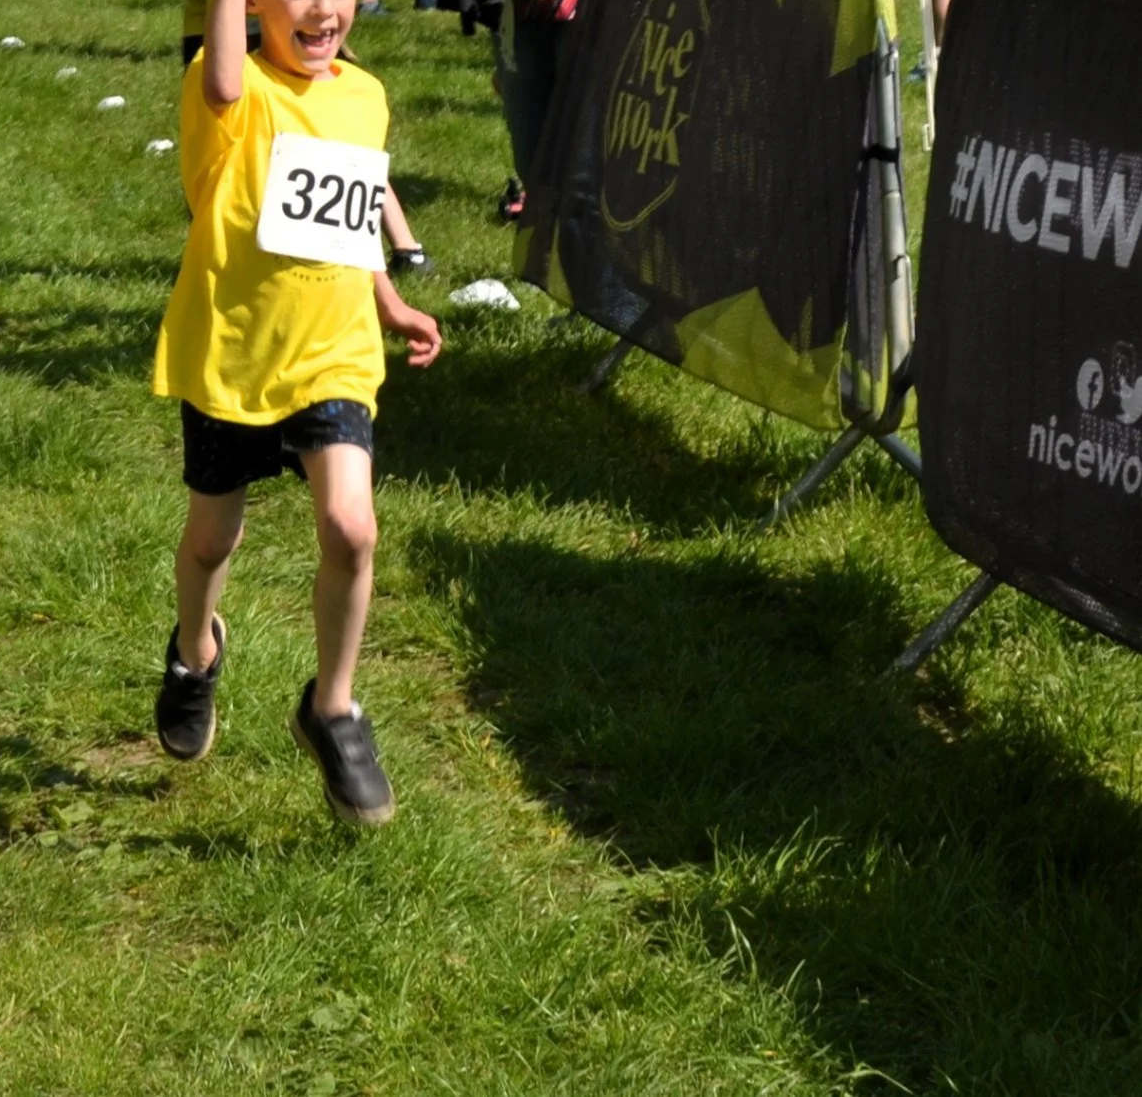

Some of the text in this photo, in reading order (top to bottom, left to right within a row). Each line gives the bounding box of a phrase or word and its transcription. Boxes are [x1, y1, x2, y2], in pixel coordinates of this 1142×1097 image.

[626, 1, 695, 97] Nice
[608, 84, 691, 175] Work
[281, 167, 387, 237] 3205
[949, 135, 1142, 269] #NICEW
